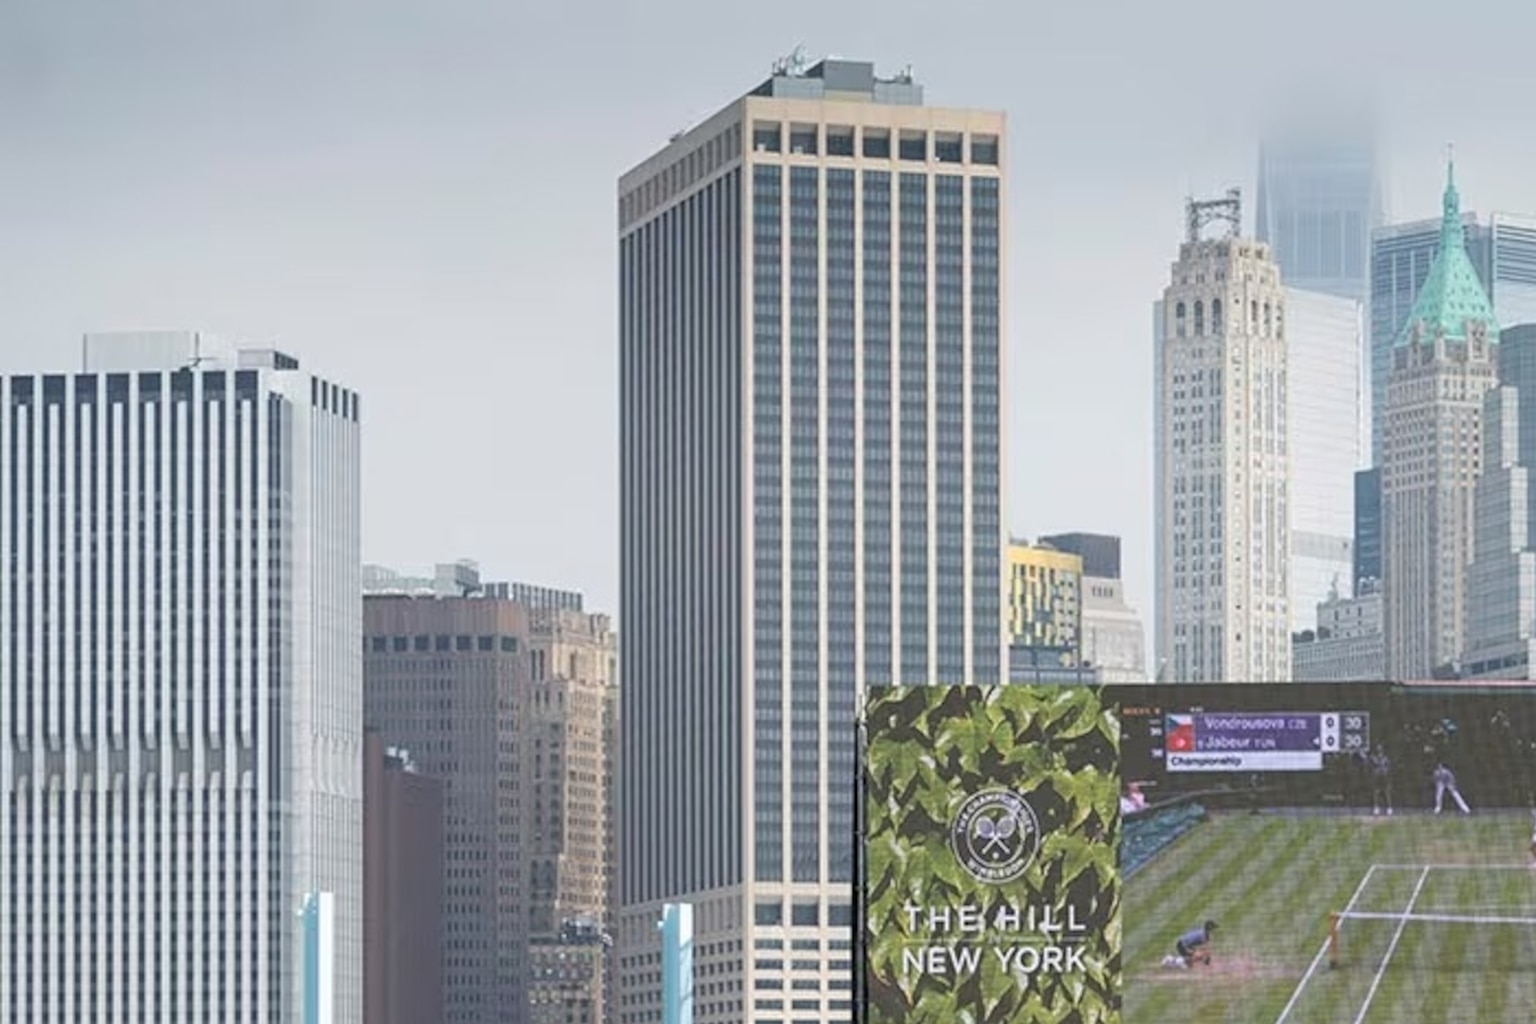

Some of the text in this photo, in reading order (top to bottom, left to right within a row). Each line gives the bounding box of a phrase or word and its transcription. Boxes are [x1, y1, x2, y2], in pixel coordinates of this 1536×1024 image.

[1204, 717, 1285, 730] Vondrousova
[1326, 717, 1335, 728] 0
[1206, 736, 1251, 749] Jabeur
[1326, 736, 1335, 746] 0
[1345, 736, 1362, 747] 30
[1171, 757, 1242, 767] Championship
[904, 905, 1087, 932] THE HILL
[903, 946, 1087, 974] NEW YORK
